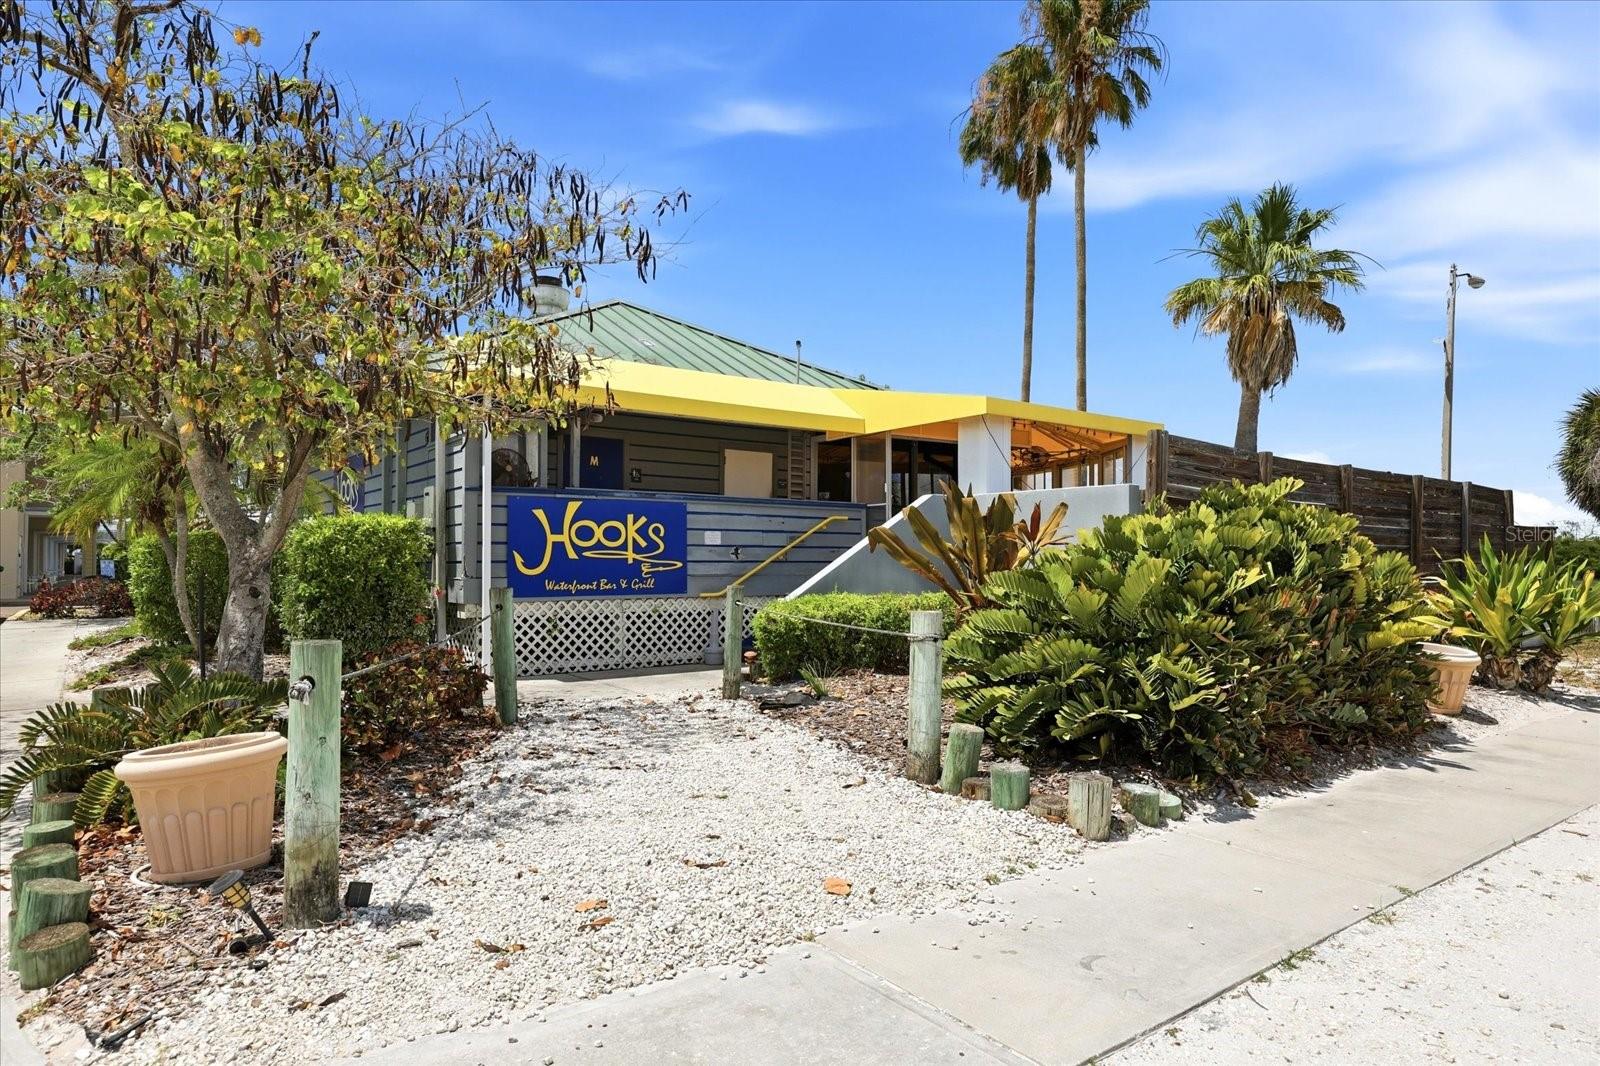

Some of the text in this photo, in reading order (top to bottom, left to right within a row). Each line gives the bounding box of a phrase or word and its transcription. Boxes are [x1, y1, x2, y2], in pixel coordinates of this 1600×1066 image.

[590, 455, 599, 467] M
[545, 578, 655, 594] Waterfront Bar & Grill
